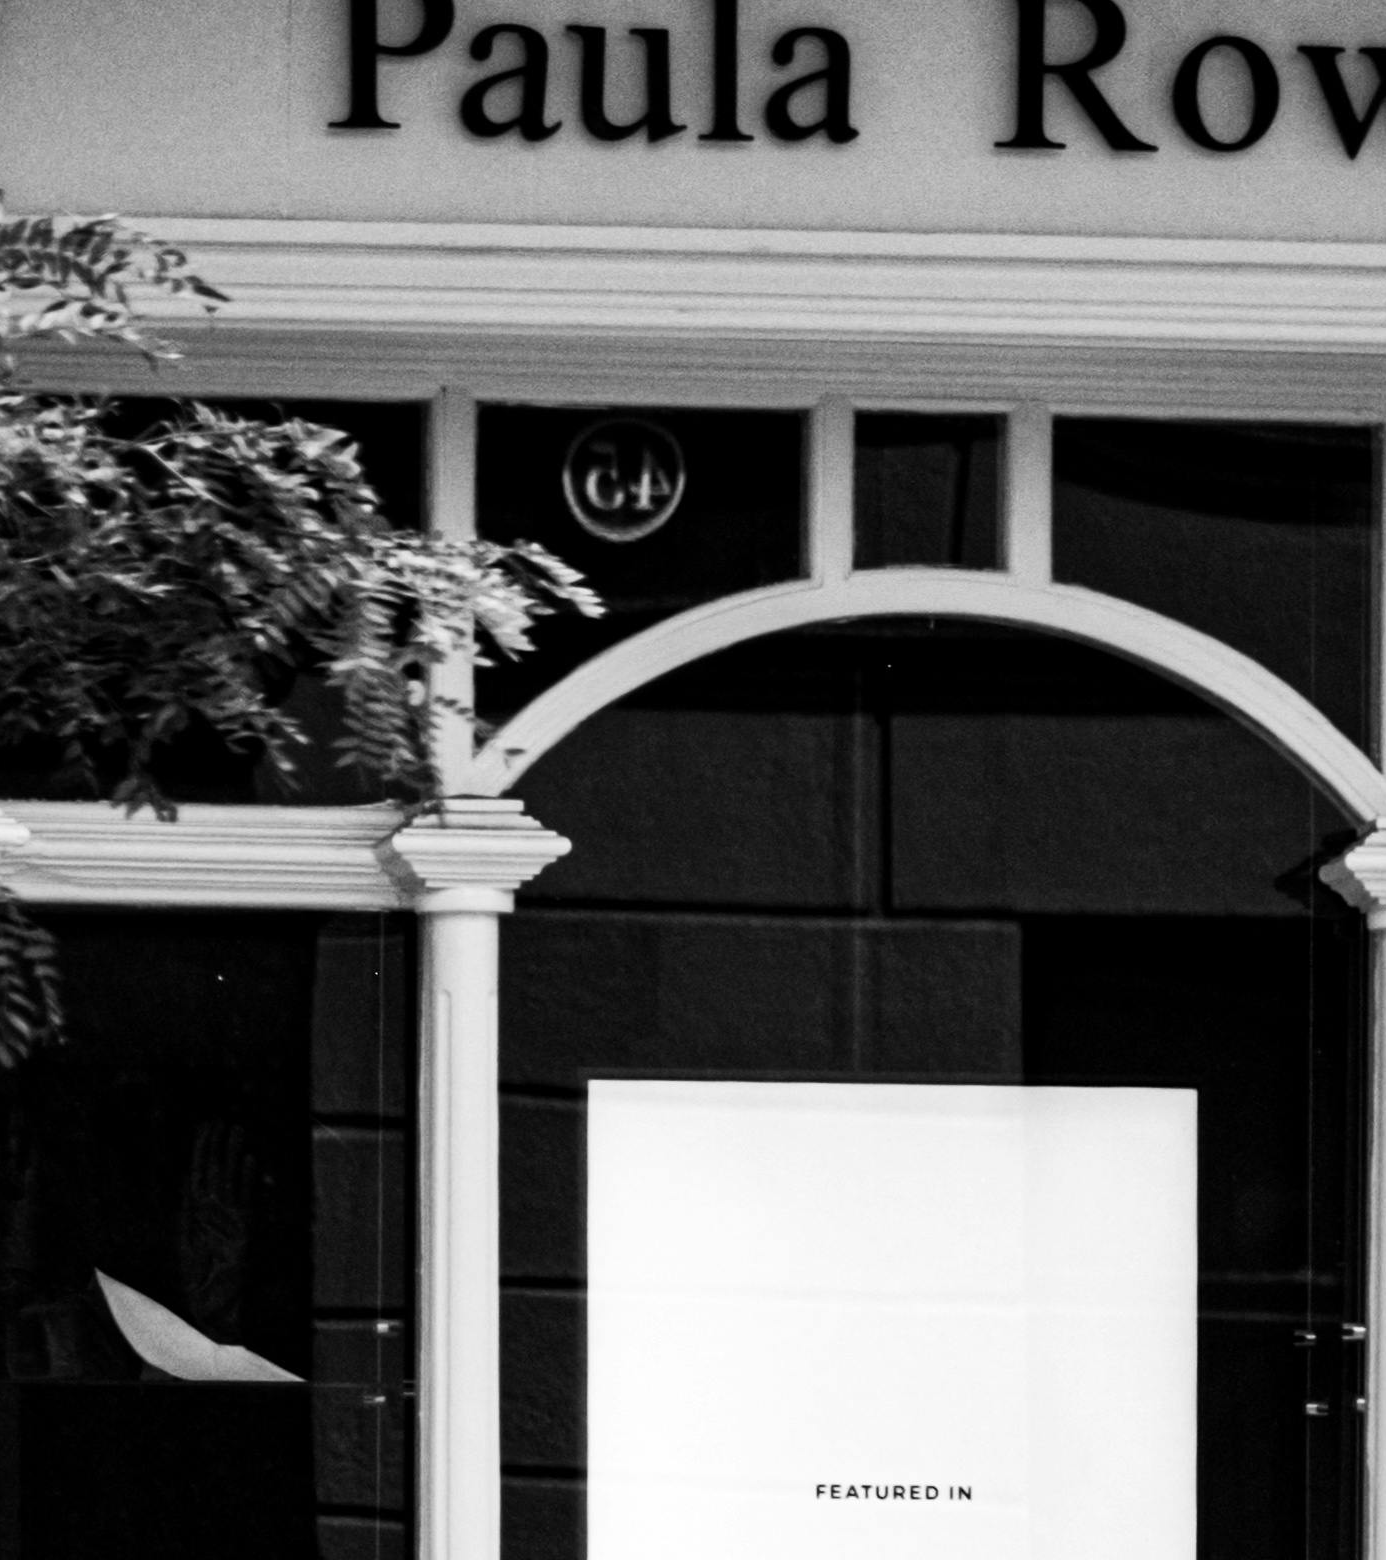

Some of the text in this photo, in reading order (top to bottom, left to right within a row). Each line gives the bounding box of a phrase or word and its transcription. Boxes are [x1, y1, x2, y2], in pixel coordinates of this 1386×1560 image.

[327, 0, 860, 145] Paula
[815, 1484, 973, 1501] FEATURED IN
